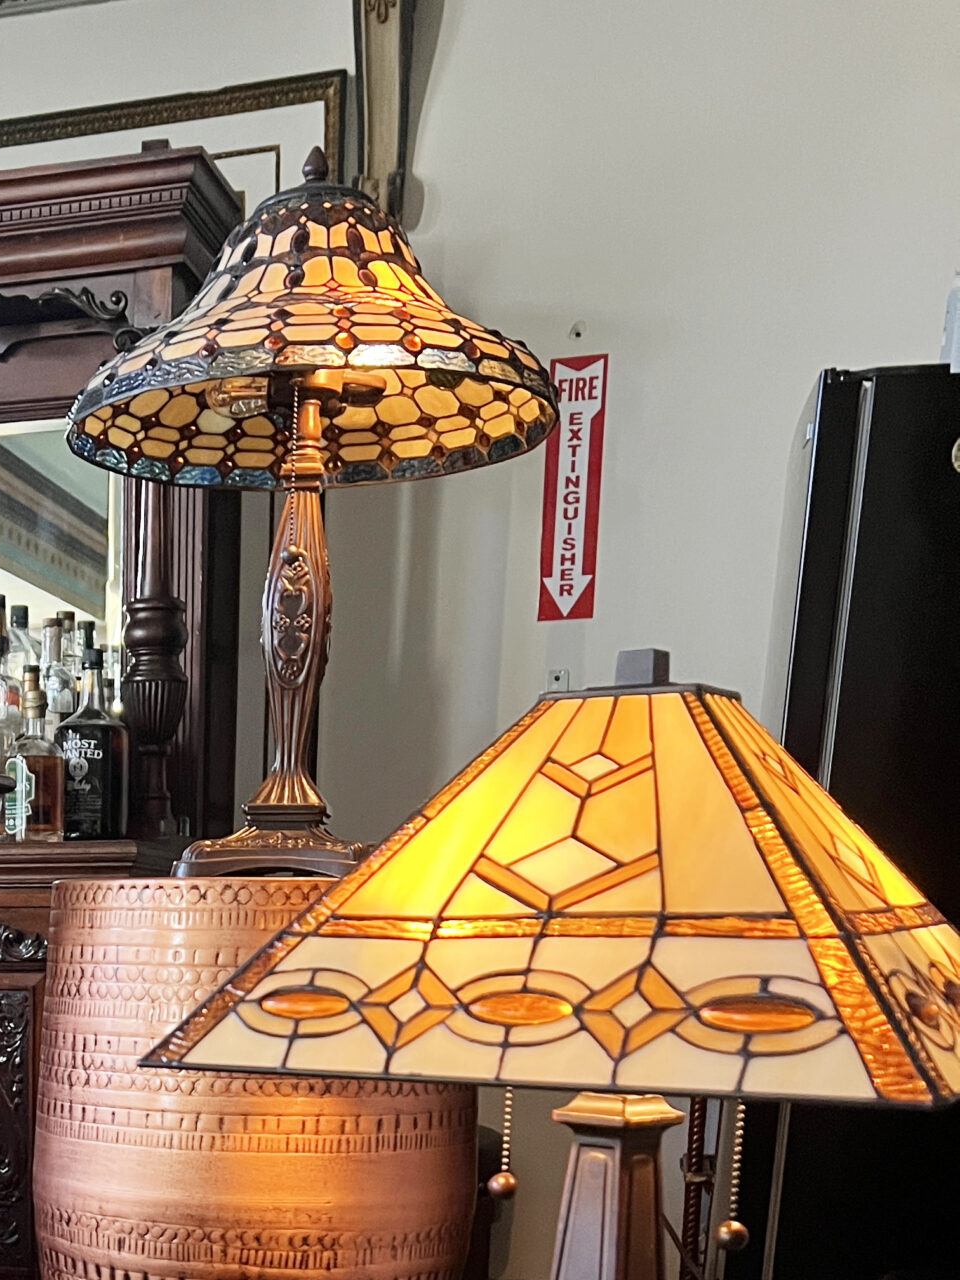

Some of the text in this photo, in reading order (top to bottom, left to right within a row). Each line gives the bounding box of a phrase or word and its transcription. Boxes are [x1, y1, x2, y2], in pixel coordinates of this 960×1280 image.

[558, 376, 599, 403] FIRE
[559, 412, 583, 597] EXTINGUISHER
[62, 739, 98, 751] MOST
